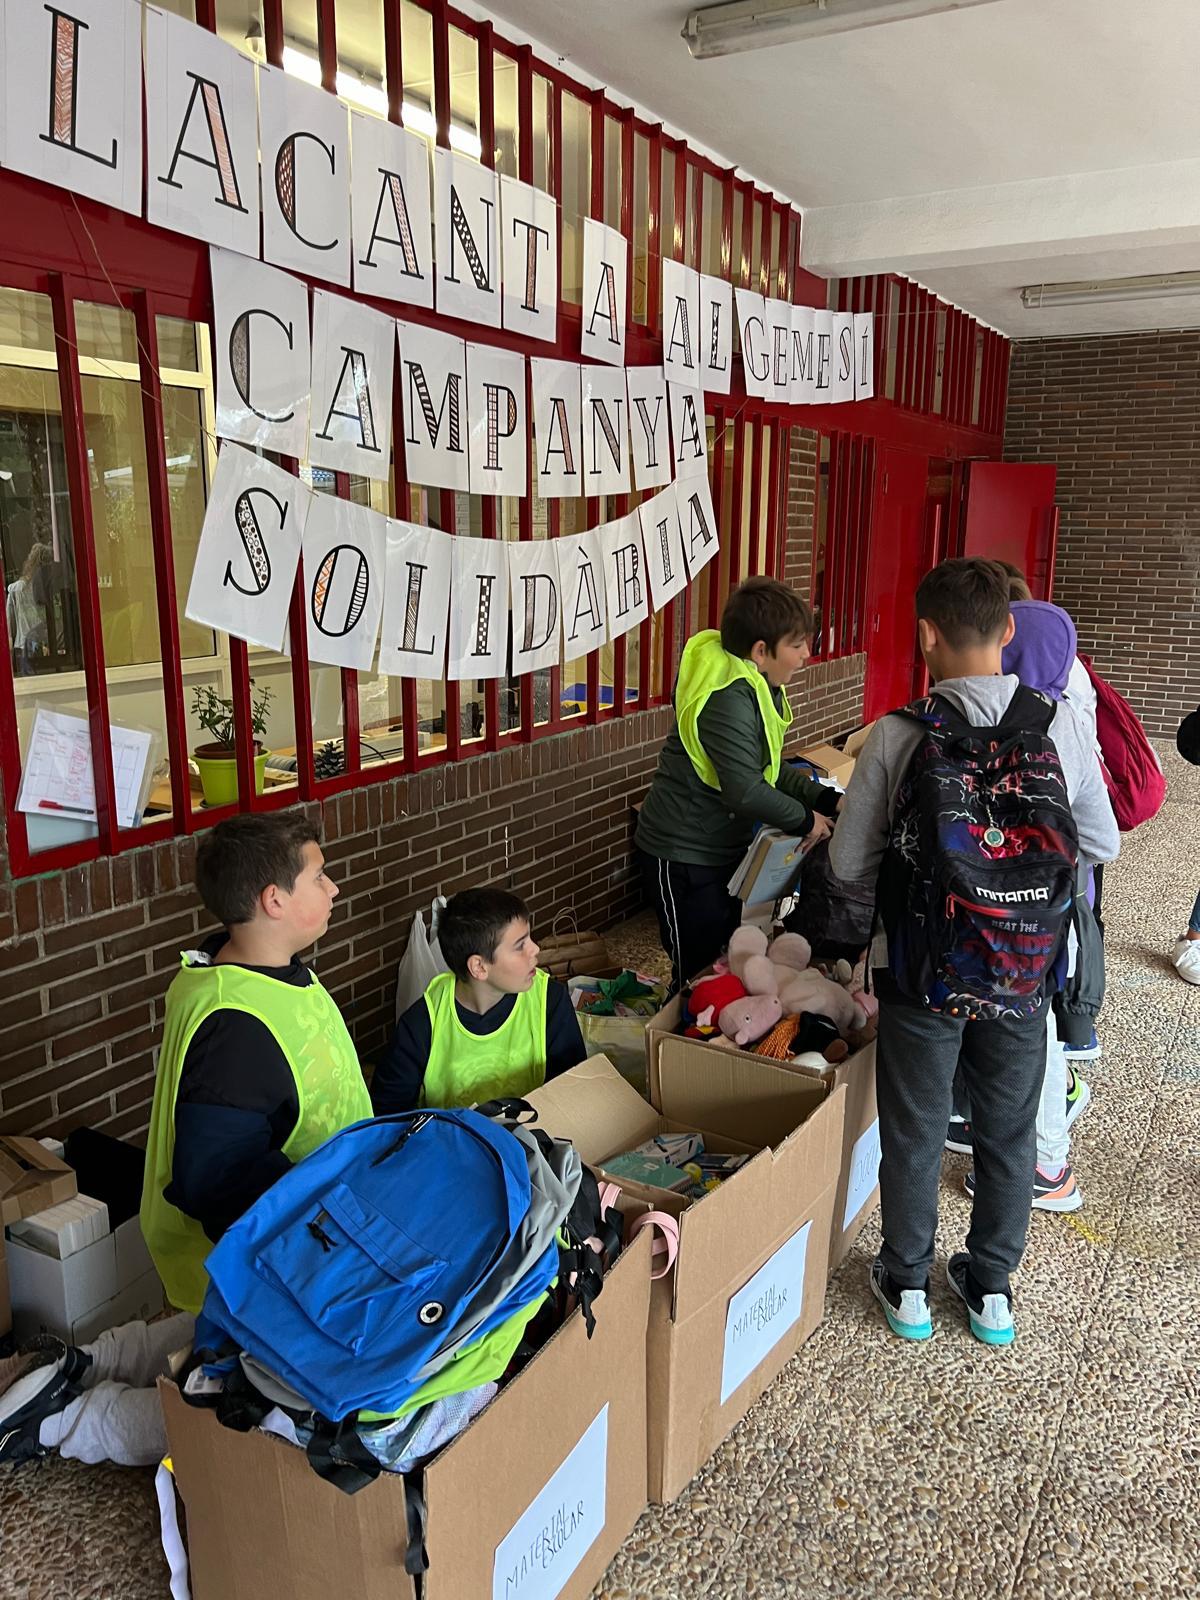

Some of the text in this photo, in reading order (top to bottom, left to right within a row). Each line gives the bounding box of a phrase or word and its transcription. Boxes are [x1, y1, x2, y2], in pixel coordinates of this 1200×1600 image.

[585, 261, 621, 346] A
[229, 308, 705, 475] CAMPANYA
[222, 486, 714, 657] SOLIDÀRIA
[975, 886, 1049, 903] MITAMA
[1018, 918, 1040, 933] THE
[732, 1283, 777, 1345] MATERIAL
[757, 1288, 788, 1332] ESCOLAR
[504, 1502, 569, 1600] MATERIAL
[541, 1499, 584, 1570] ESCOLAR
